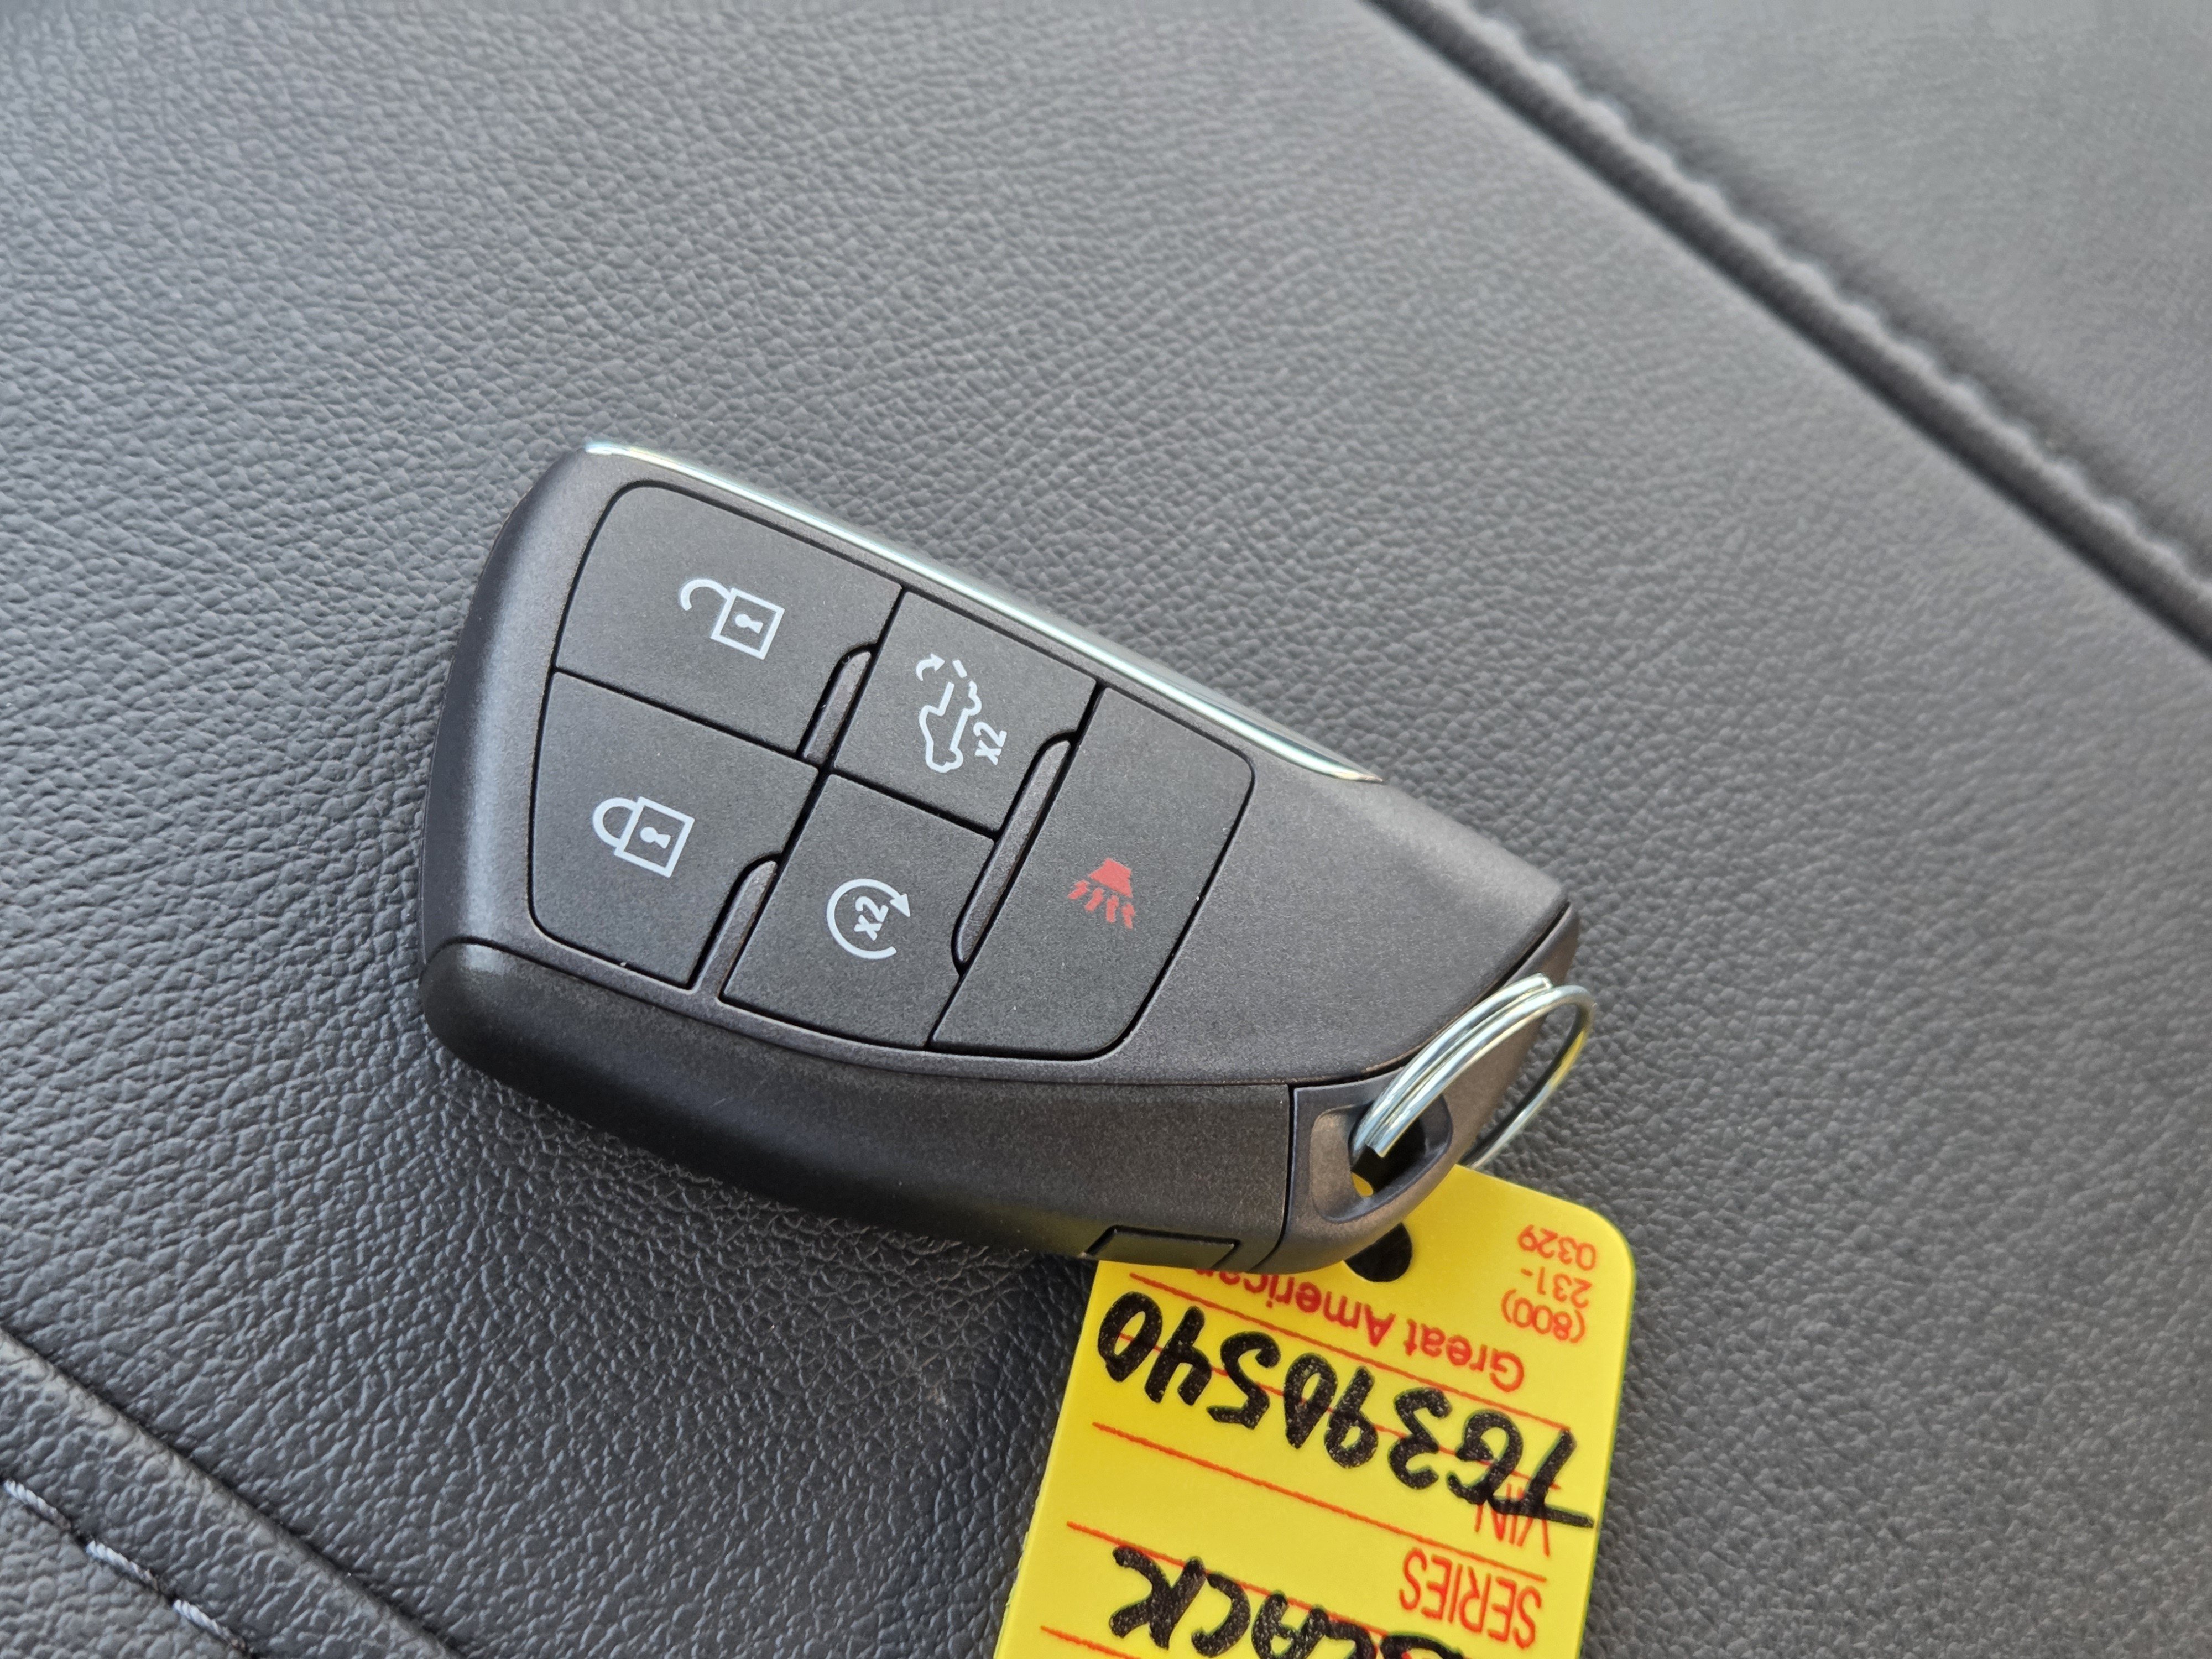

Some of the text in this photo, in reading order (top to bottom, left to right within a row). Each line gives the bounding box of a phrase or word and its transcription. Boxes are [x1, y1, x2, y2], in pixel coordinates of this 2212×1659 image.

[973, 721, 1007, 765] x2
[854, 895, 889, 940] x2
[1517, 1224, 1597, 1271] 0329
[1520, 1266, 1592, 1309] 231-
[1194, 1269, 1525, 1393] Great Americ
[1501, 1288, 1585, 1344] (800)
[1097, 1291, 1594, 1529] TG390540
[1474, 1483, 1550, 1557] VIN
[1398, 1546, 1542, 1650] SERIES
